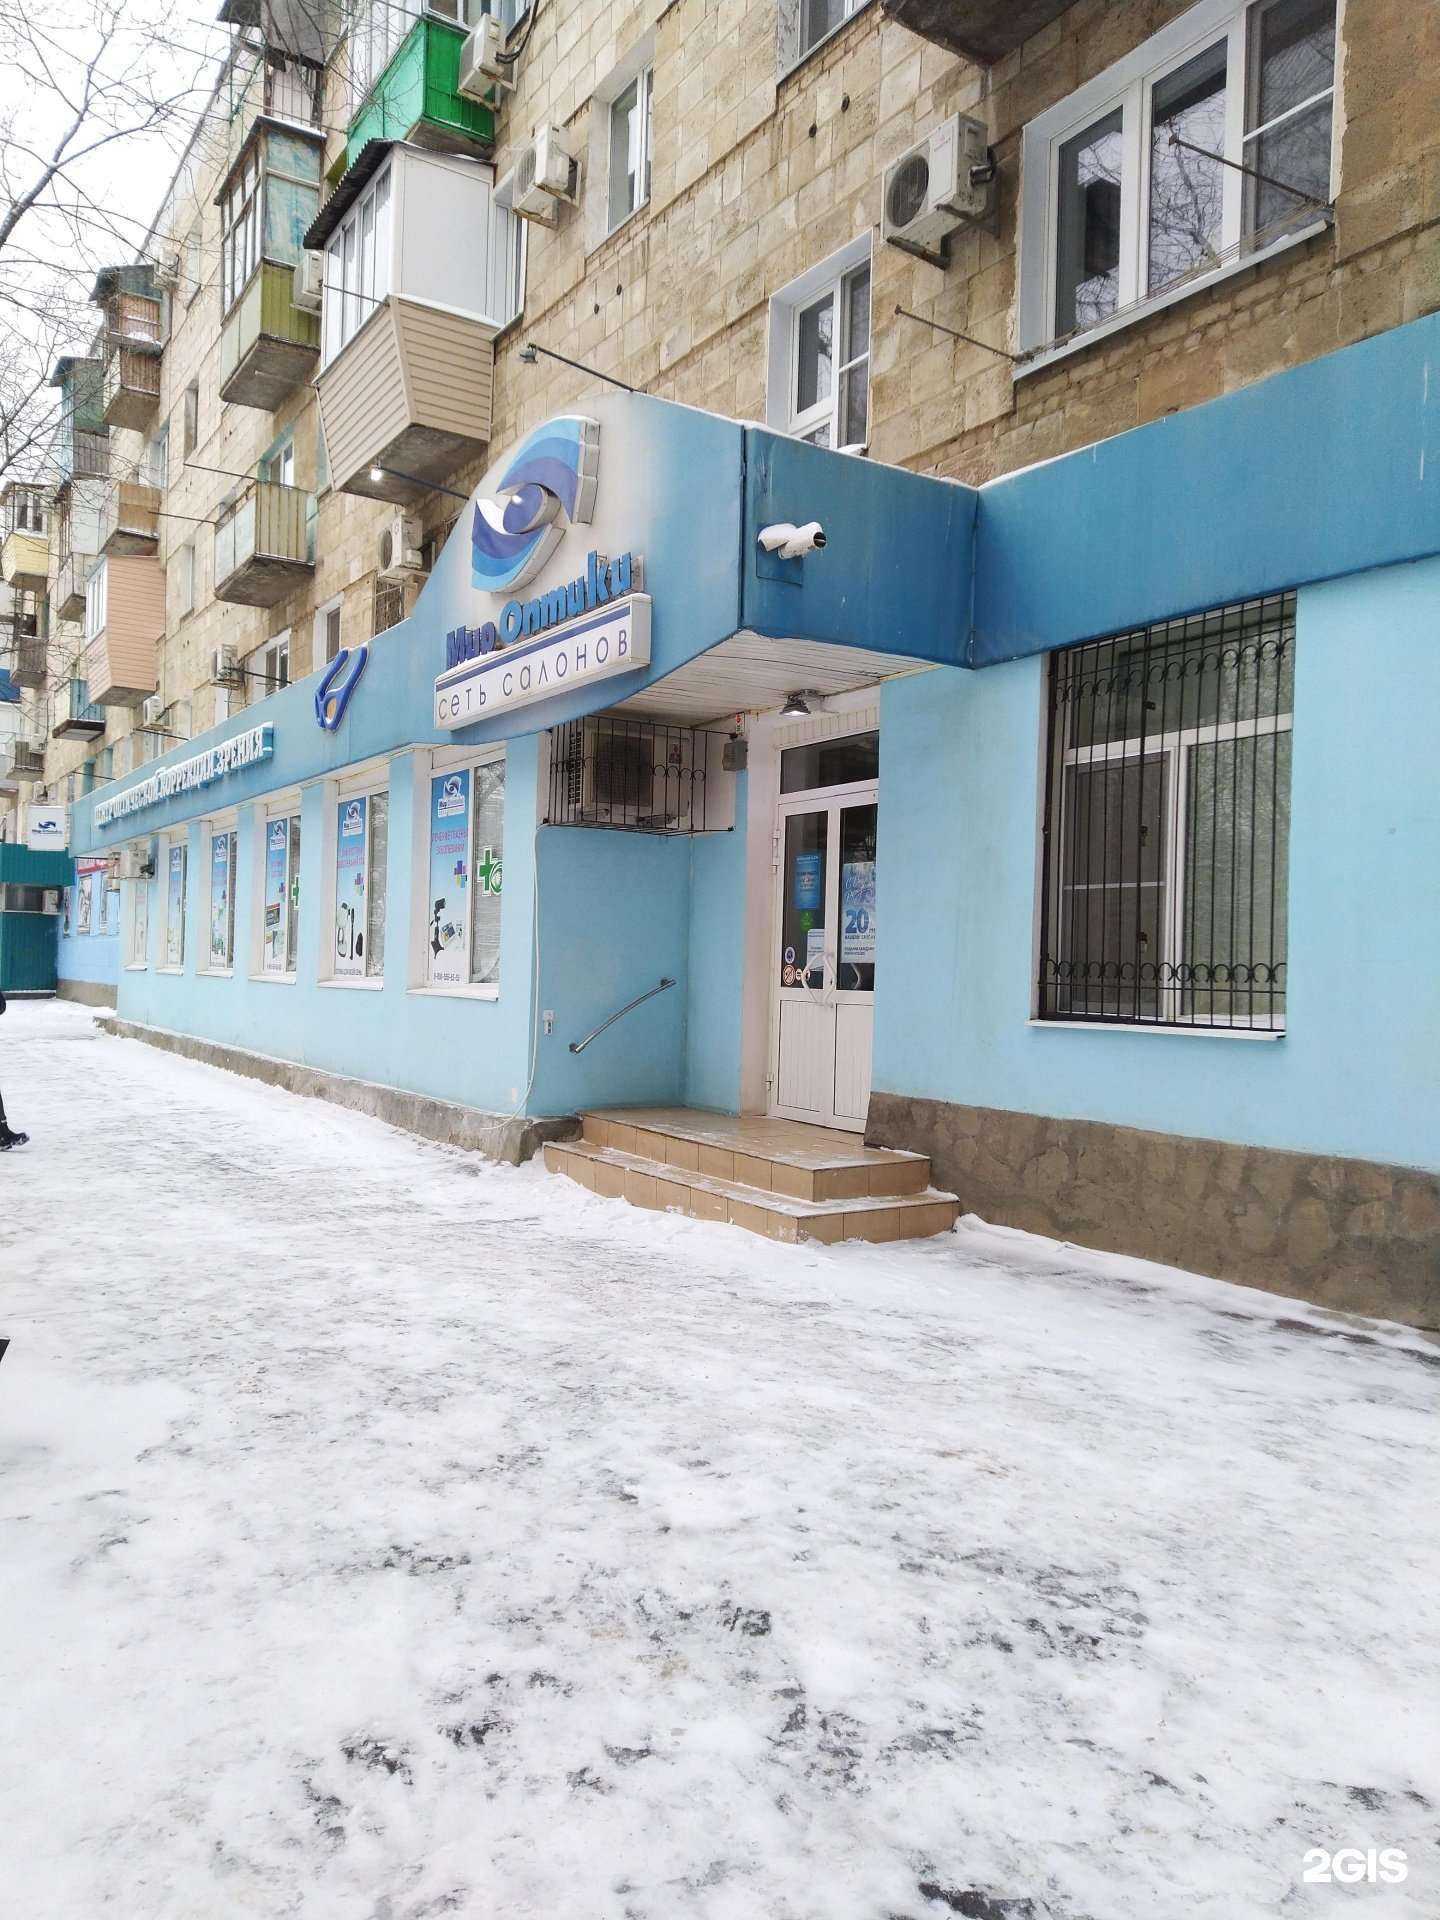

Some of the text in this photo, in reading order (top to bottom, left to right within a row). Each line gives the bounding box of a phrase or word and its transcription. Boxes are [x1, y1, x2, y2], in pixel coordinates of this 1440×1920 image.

[446, 550, 632, 667] Мир Оптики
[438, 629, 628, 720] сеть салонов
[216, 727, 264, 774] ЗРЕНИЯ
[845, 908, 870, 934] 20
